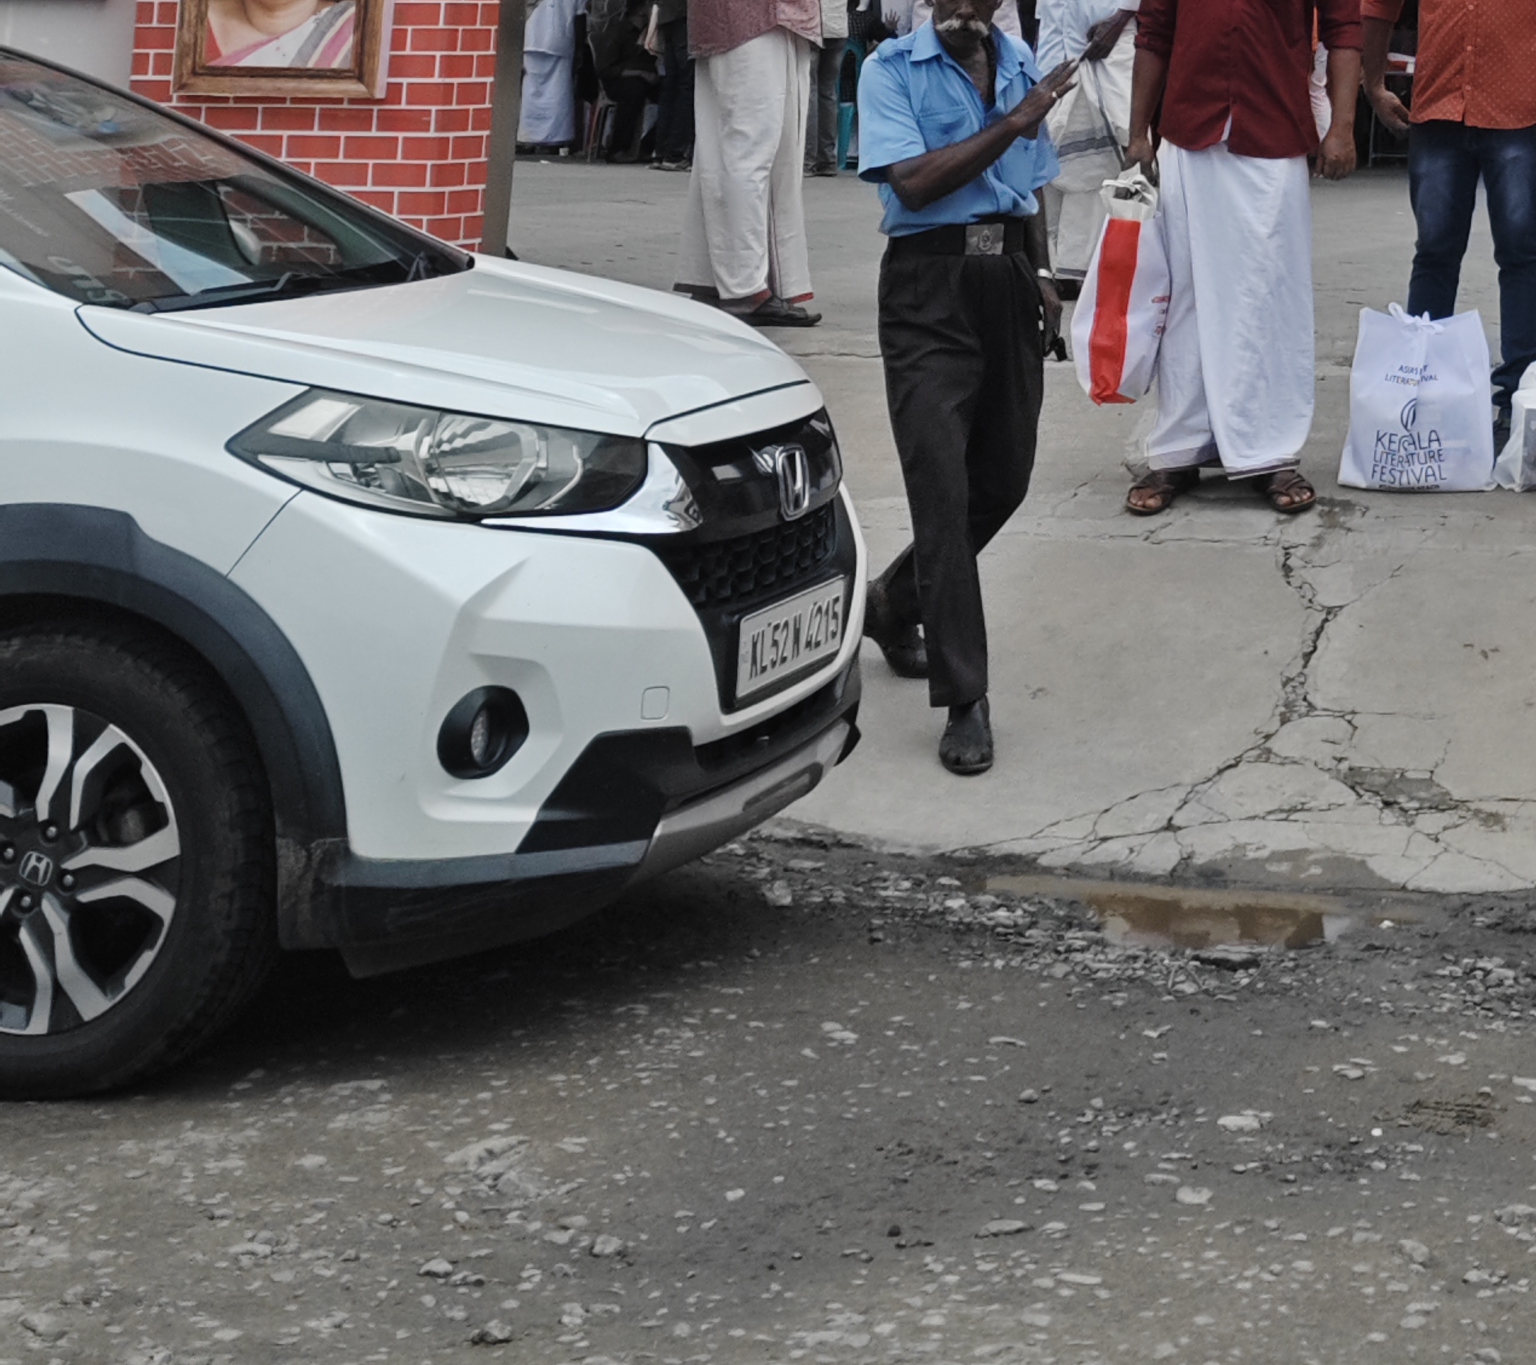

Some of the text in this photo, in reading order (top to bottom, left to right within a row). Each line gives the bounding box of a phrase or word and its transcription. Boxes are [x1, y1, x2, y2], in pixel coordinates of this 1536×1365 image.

[1374, 429, 1442, 453] KERALA
[1373, 449, 1446, 468] LITERATURE
[1371, 464, 1447, 486] FESTIVAL
[804, 595, 841, 652] 4215
